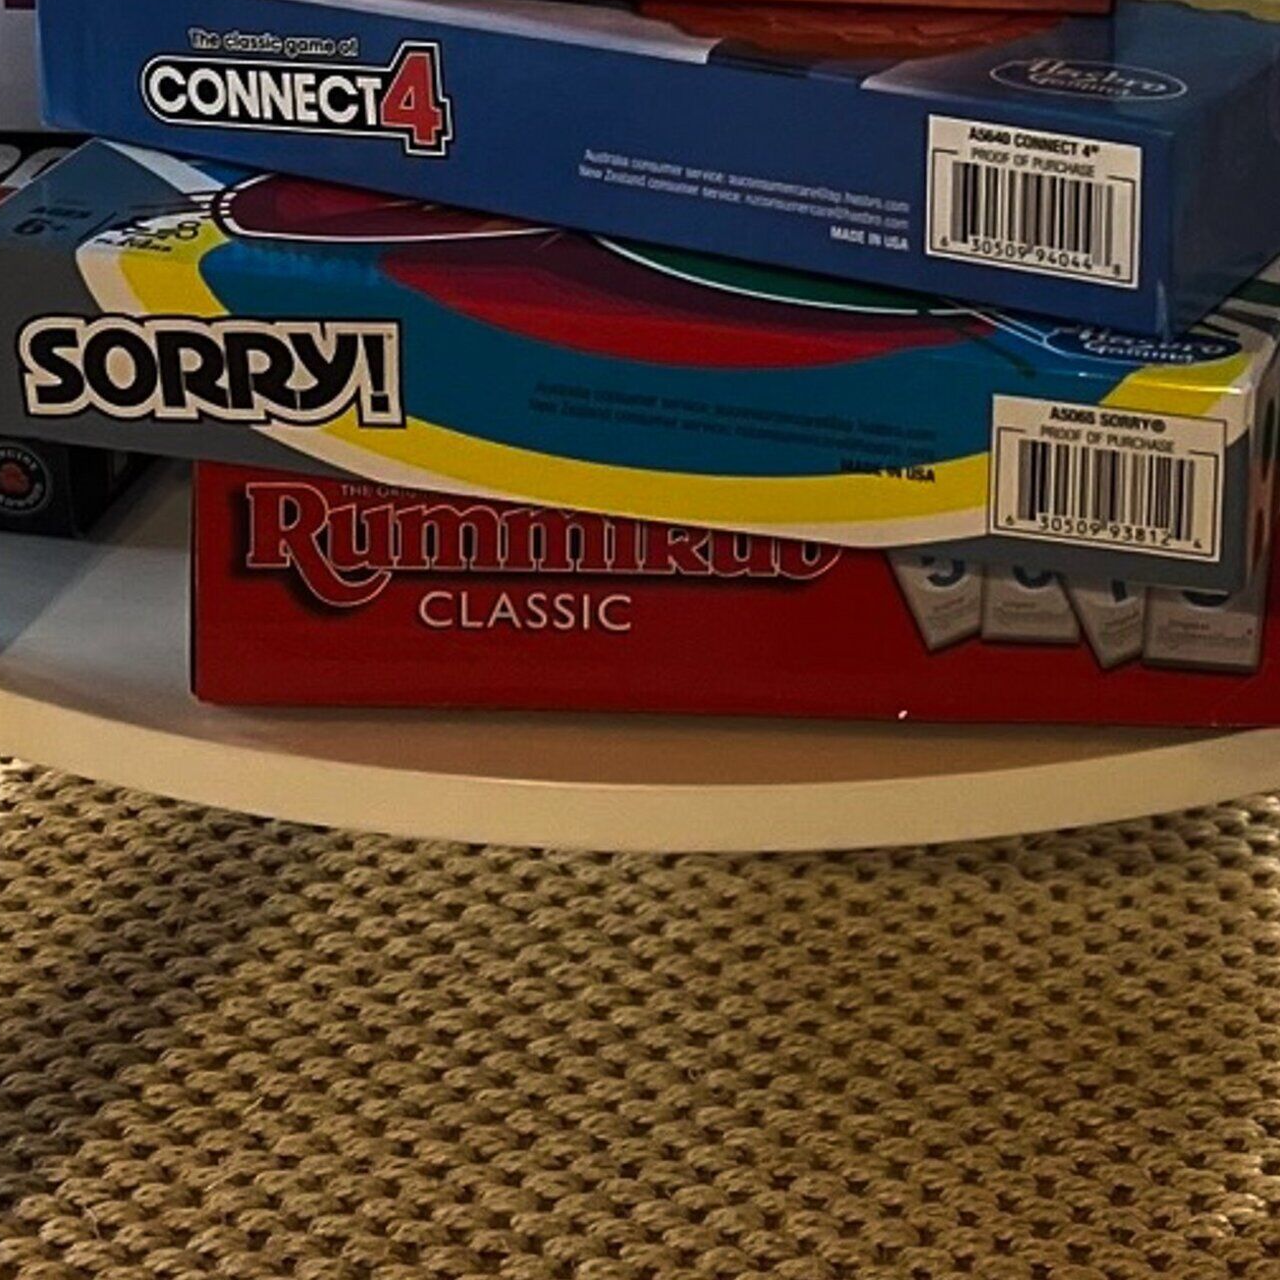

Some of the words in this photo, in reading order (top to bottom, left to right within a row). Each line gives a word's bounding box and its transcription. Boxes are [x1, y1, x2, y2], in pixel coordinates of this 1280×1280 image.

[188, 27, 220, 48] The
[223, 30, 282, 53] classic
[283, 36, 336, 58] game
[338, 36, 359, 57] of
[148, 65, 382, 126] CONNECT
[380, 50, 444, 137] 4
[1013, 132, 1078, 156] CONNECT
[971, 146, 1010, 166] PROOF
[1013, 154, 1030, 168] OF
[1032, 157, 1096, 179] PURCHASE
[830, 224, 866, 245] MADE
[867, 231, 882, 247] IN
[884, 233, 910, 252] USA
[22, 318, 400, 423] SORRY!
[1040, 424, 1082, 443] PROOF
[1086, 430, 1103, 444] OF
[1106, 434, 1175, 453] PURCHASE
[905, 466, 935, 483] USA
[340, 483, 370, 498] THE
[420, 590, 632, 632] CLASSIC
